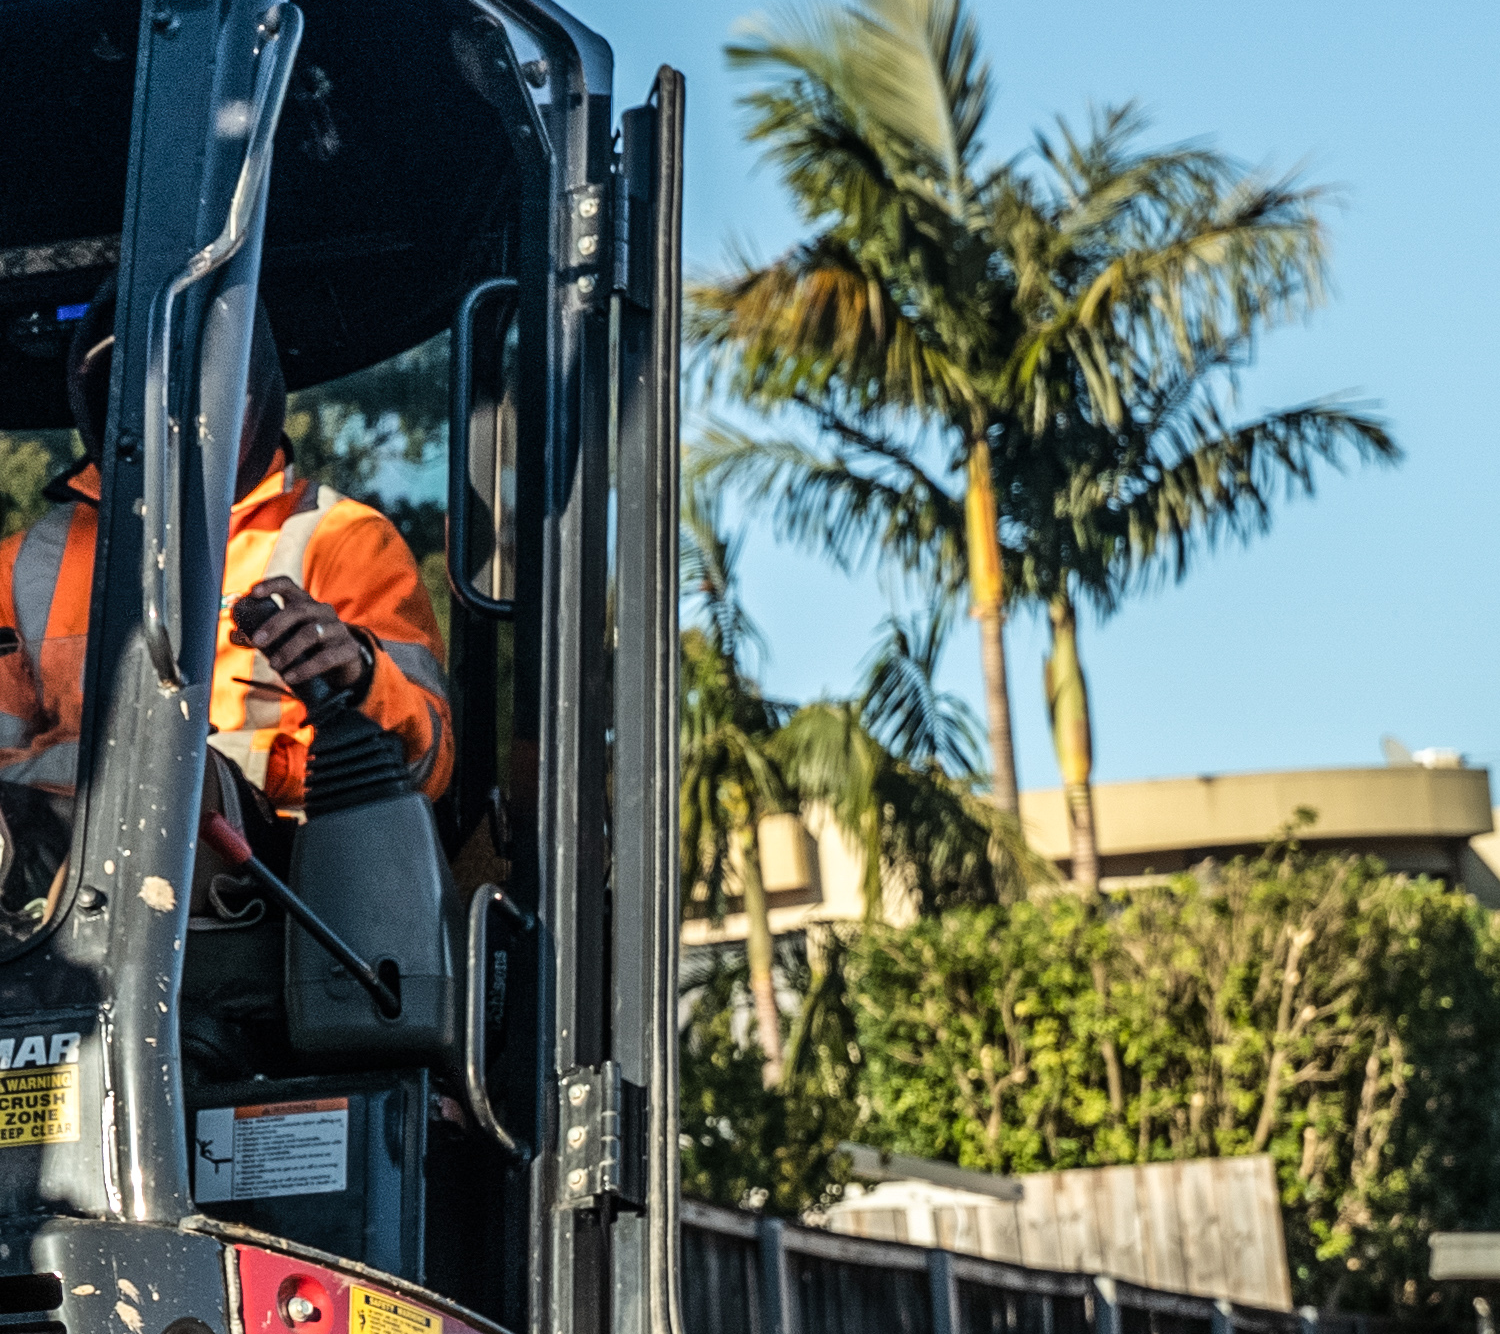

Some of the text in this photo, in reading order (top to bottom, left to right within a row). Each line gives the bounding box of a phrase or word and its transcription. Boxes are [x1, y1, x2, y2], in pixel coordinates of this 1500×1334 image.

[6, 1074, 72, 1092] WARNING
[5, 1109, 58, 1126] ZONE
[31, 1122, 73, 1138] CLEAR
